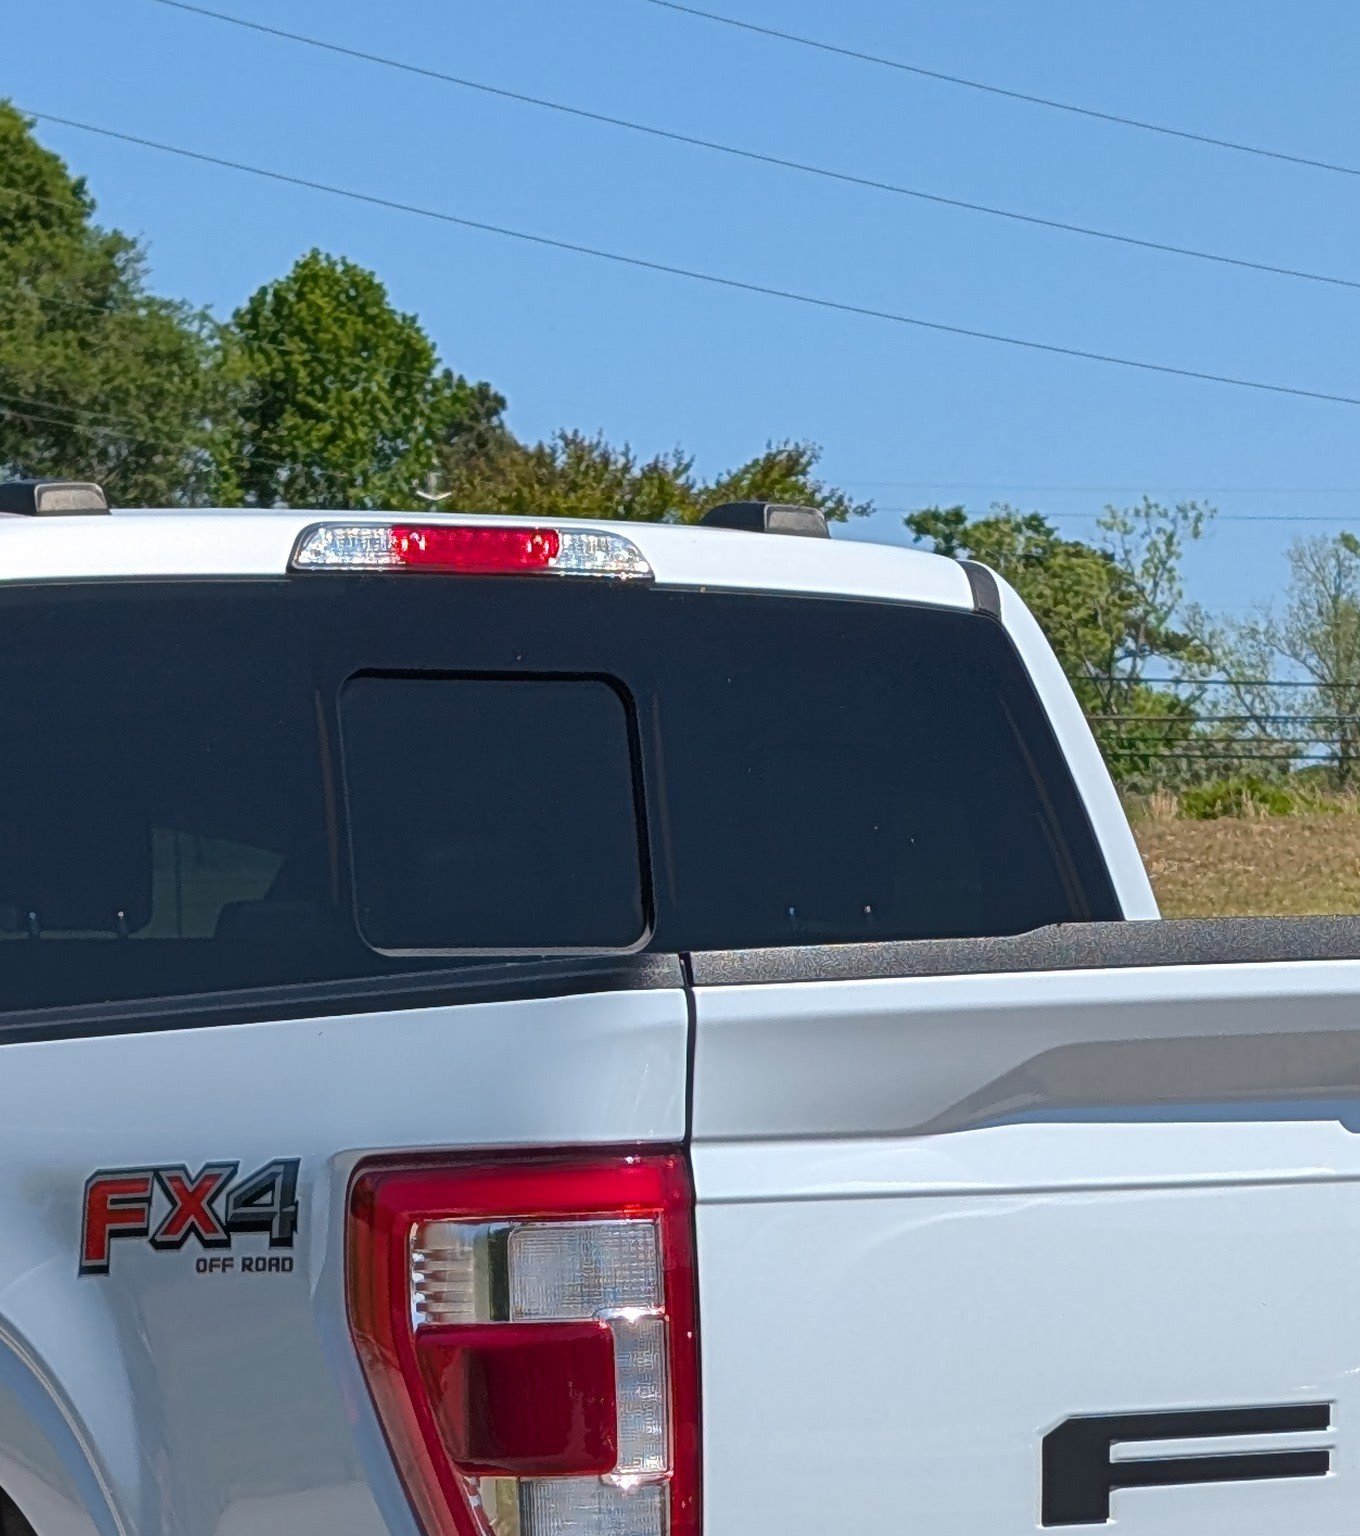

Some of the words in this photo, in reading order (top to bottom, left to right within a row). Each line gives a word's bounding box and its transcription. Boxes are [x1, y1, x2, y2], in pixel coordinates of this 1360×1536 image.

[78, 1157, 301, 1277] FX4
[195, 1256, 235, 1274] OFF
[241, 1255, 295, 1274] ROAD
